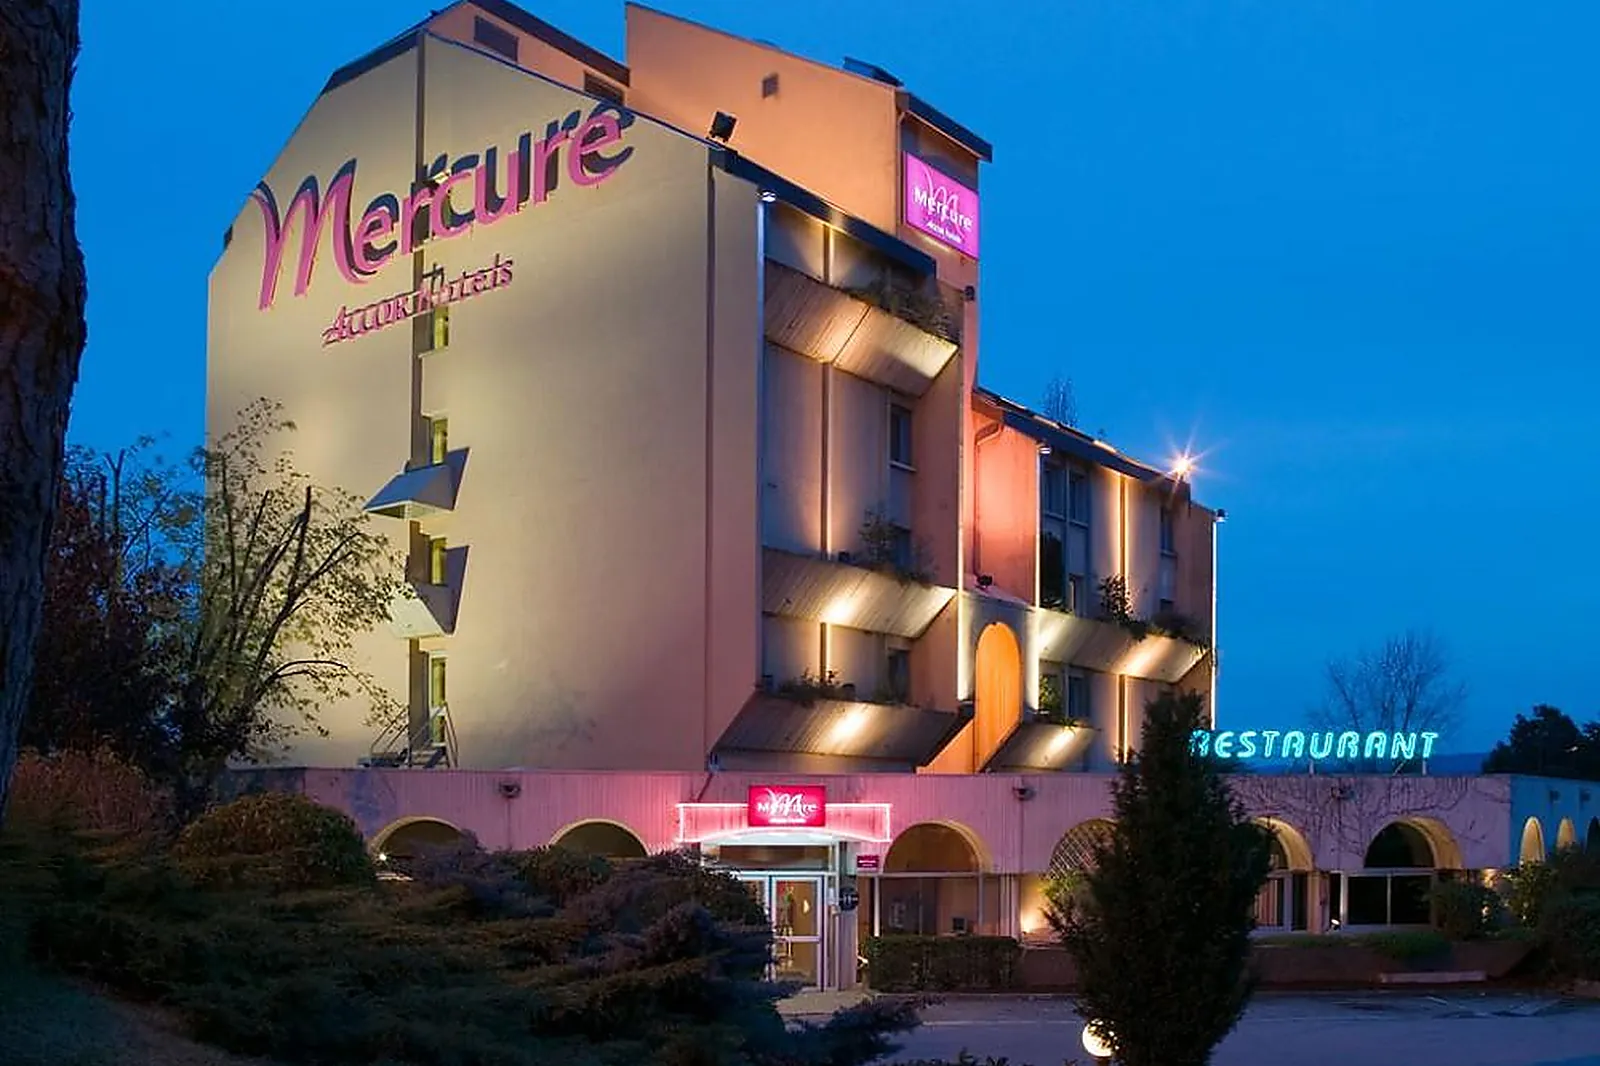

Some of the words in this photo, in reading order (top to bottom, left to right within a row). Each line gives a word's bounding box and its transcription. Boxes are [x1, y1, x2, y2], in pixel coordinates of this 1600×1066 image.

[252, 103, 634, 310] Mercure
[912, 184, 973, 231] Mercure
[1190, 730, 1438, 758] RESTAURANT
